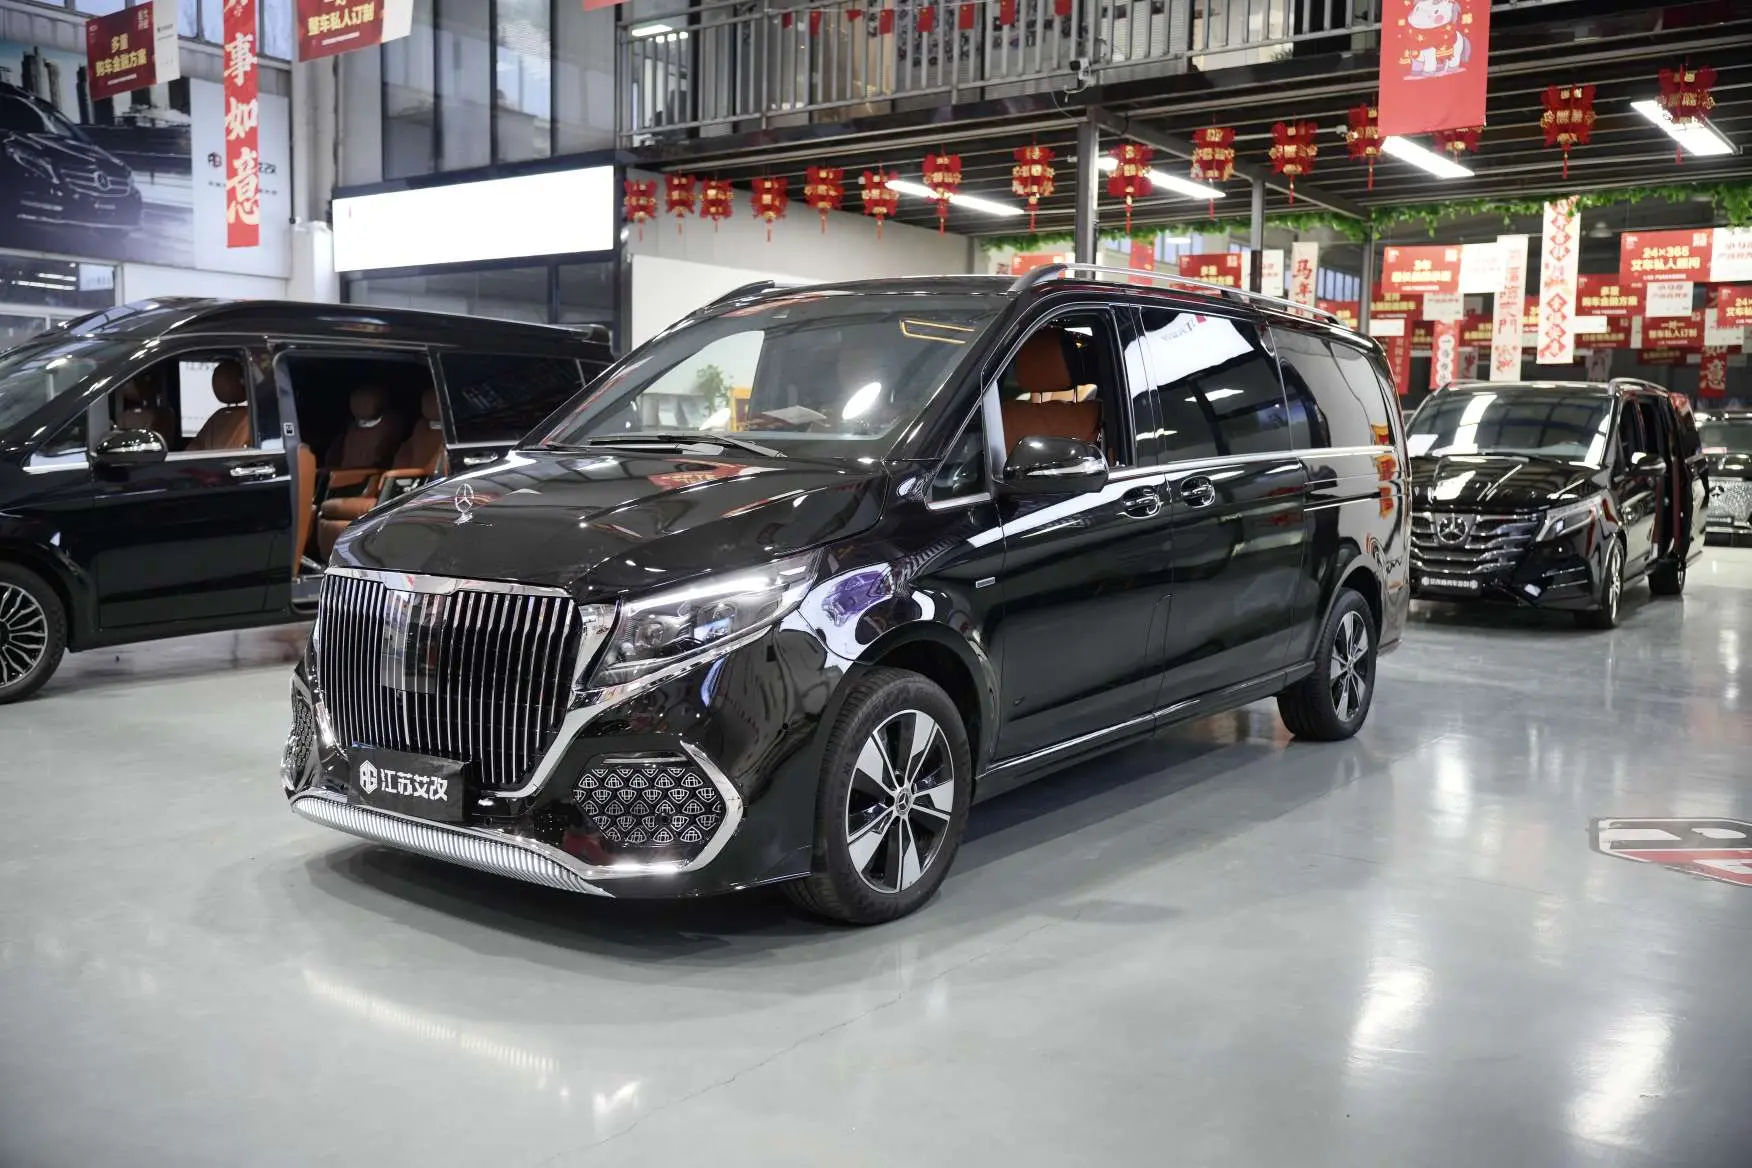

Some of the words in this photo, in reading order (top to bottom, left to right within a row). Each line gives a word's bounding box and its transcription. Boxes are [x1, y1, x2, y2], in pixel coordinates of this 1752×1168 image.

[307, 2, 375, 36] 整车私人订制
[380, 768, 448, 801] 江苏艾改
